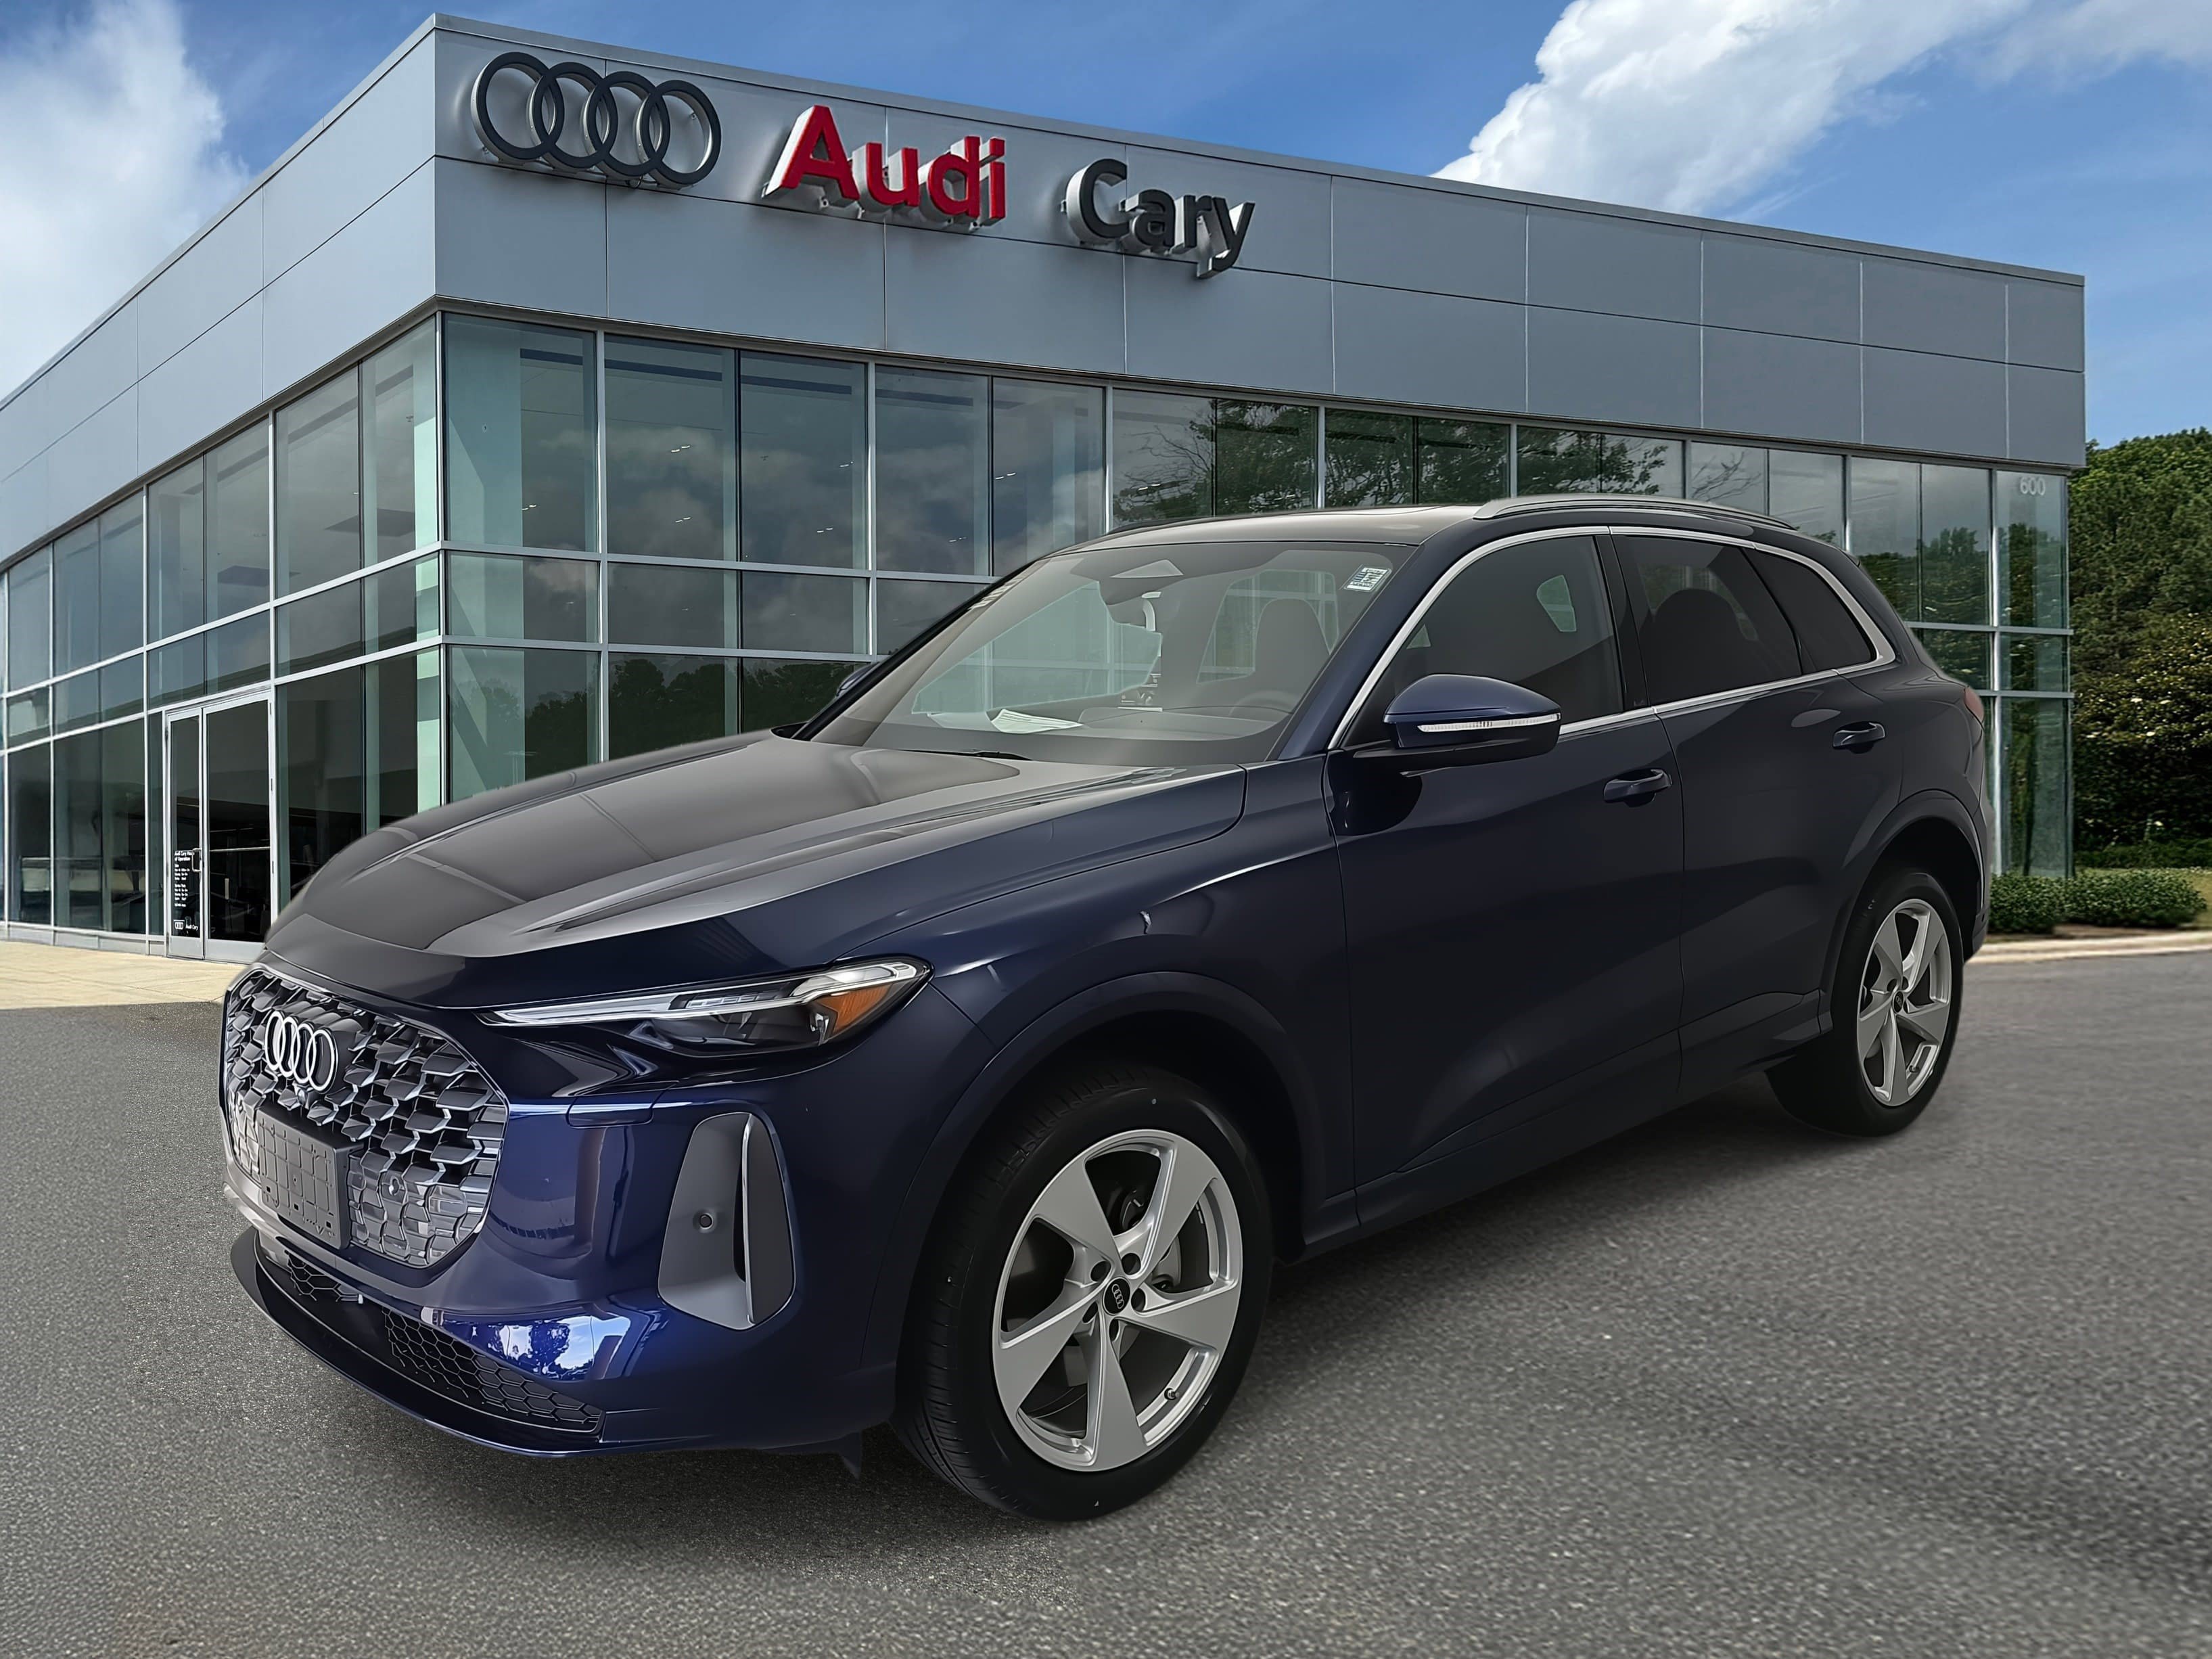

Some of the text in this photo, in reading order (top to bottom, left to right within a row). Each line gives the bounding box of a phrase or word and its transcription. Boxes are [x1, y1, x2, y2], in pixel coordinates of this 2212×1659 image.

[768, 104, 1256, 278] Audi Cary
[2020, 476, 2046, 495] 600
